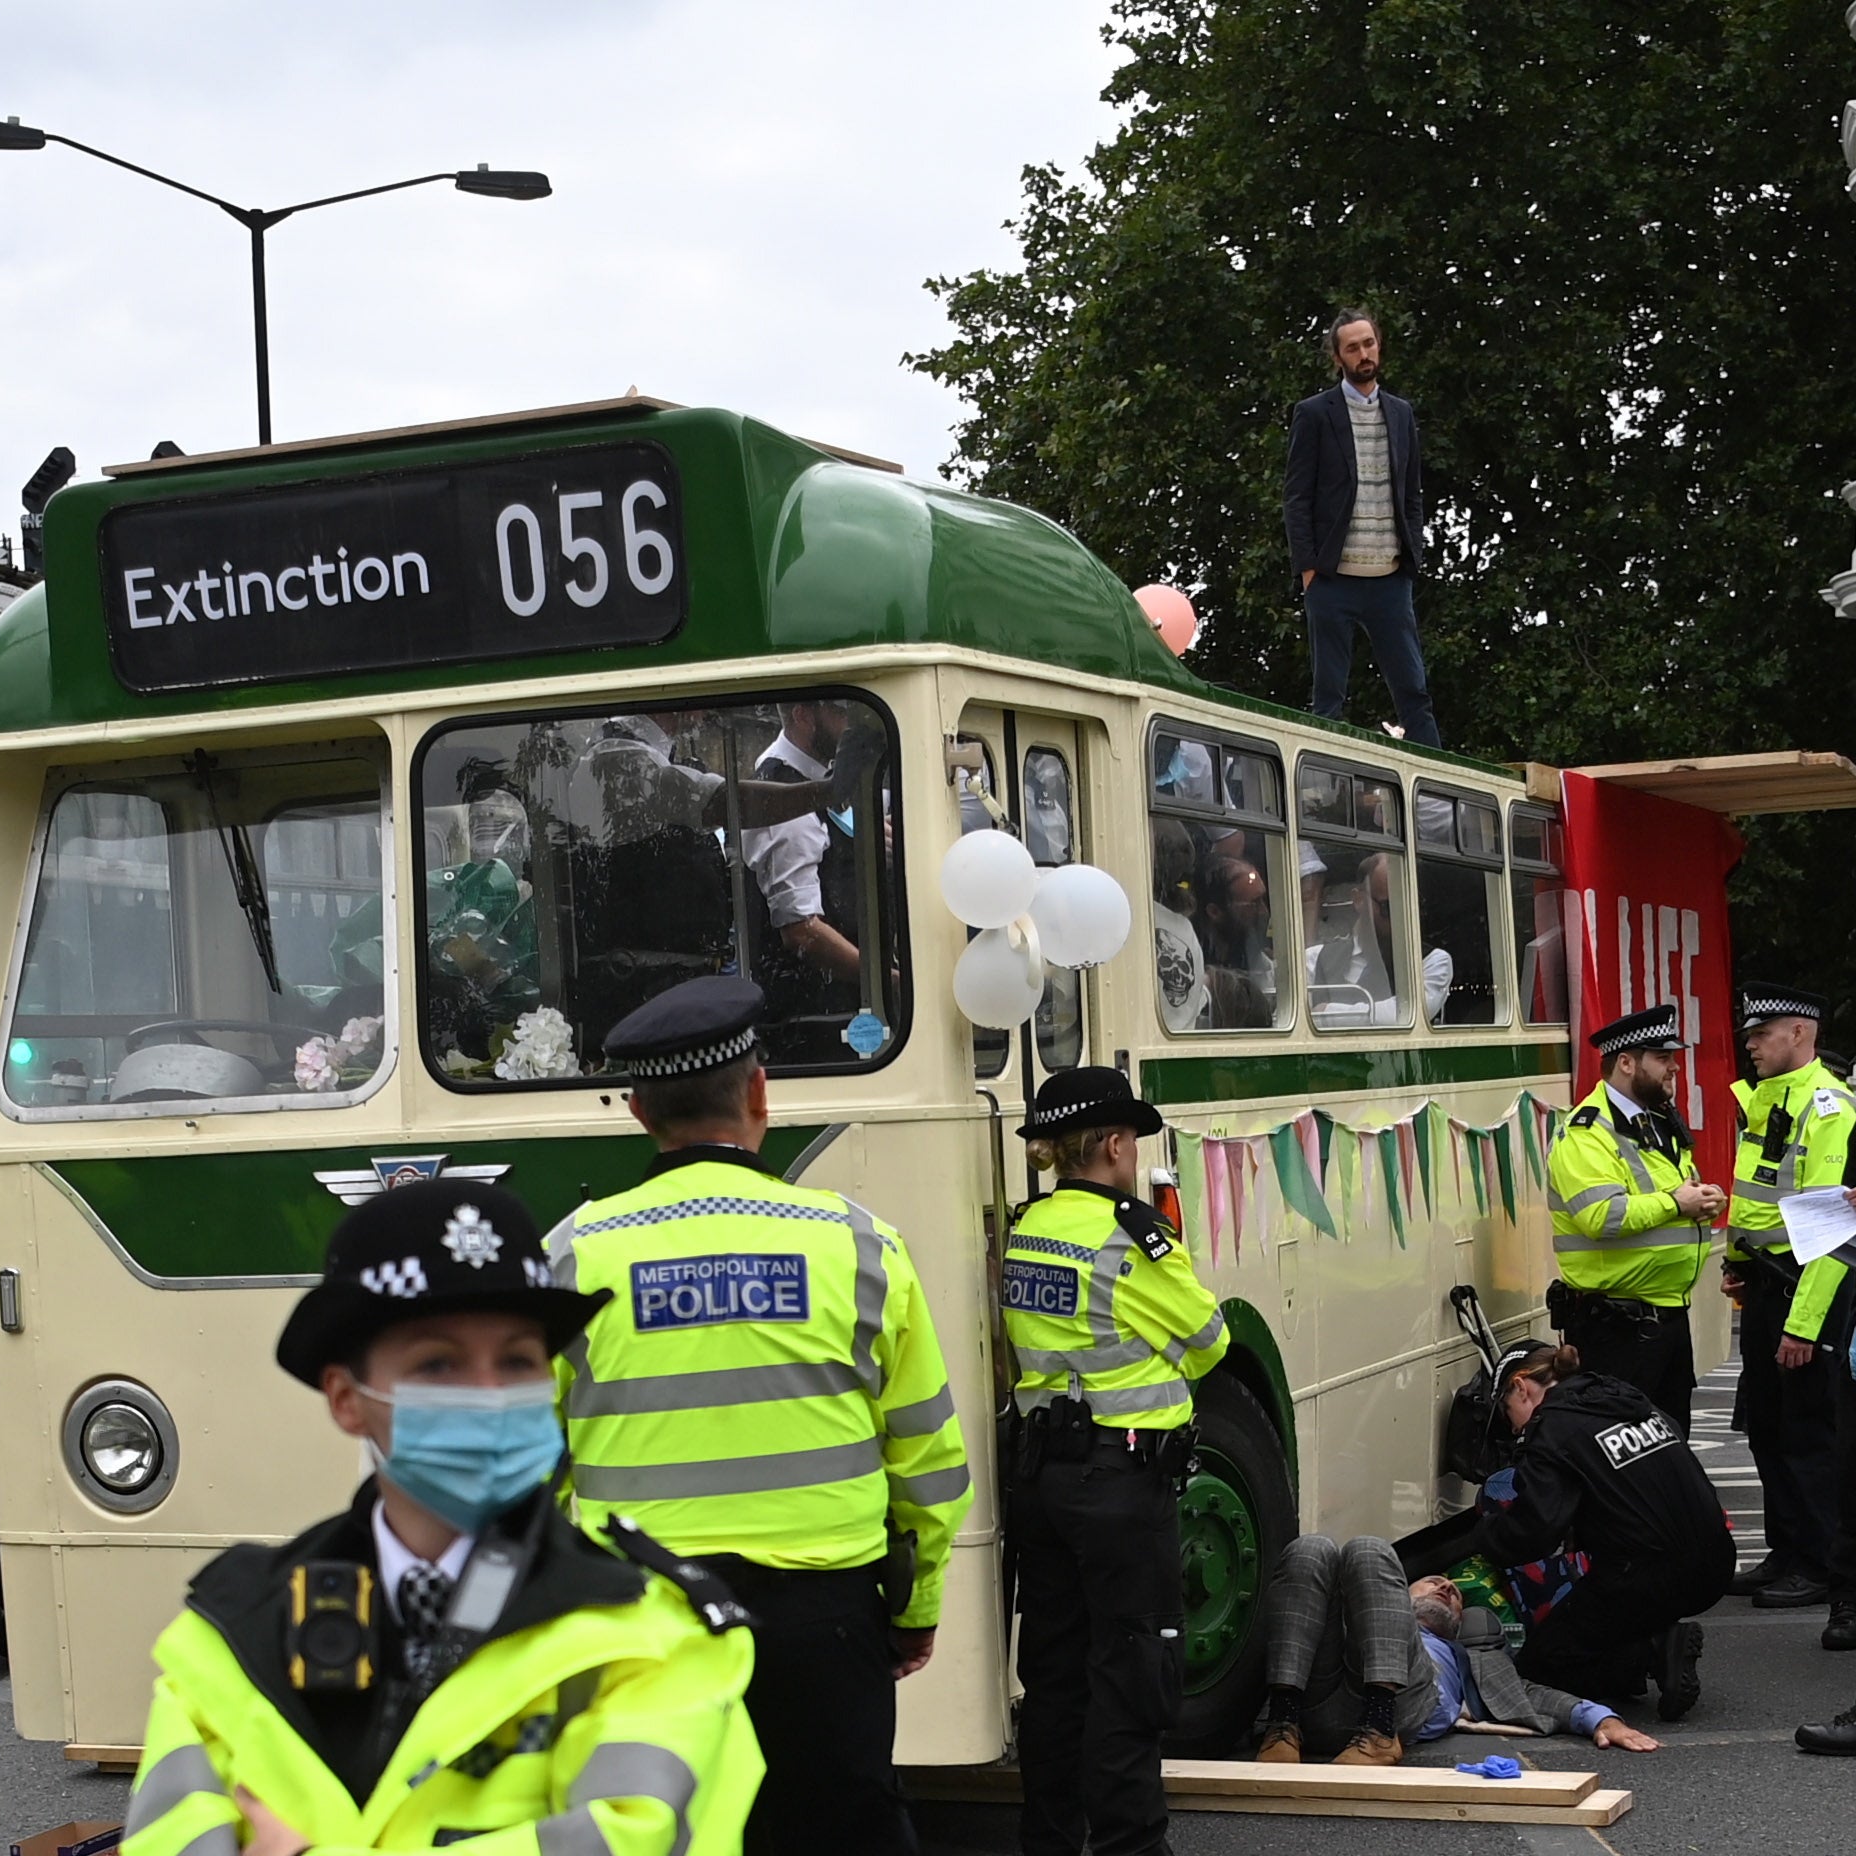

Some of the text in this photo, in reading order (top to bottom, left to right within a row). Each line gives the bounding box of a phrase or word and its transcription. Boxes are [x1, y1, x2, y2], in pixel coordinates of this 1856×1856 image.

[494, 478, 675, 616] 056
[124, 546, 431, 629] Extinction
[638, 1258, 799, 1285] METROPOLITAN
[640, 1279, 802, 1323] POLICE
[1003, 1278, 1075, 1312] POLICE
[1604, 1415, 1674, 1461] POLICE
